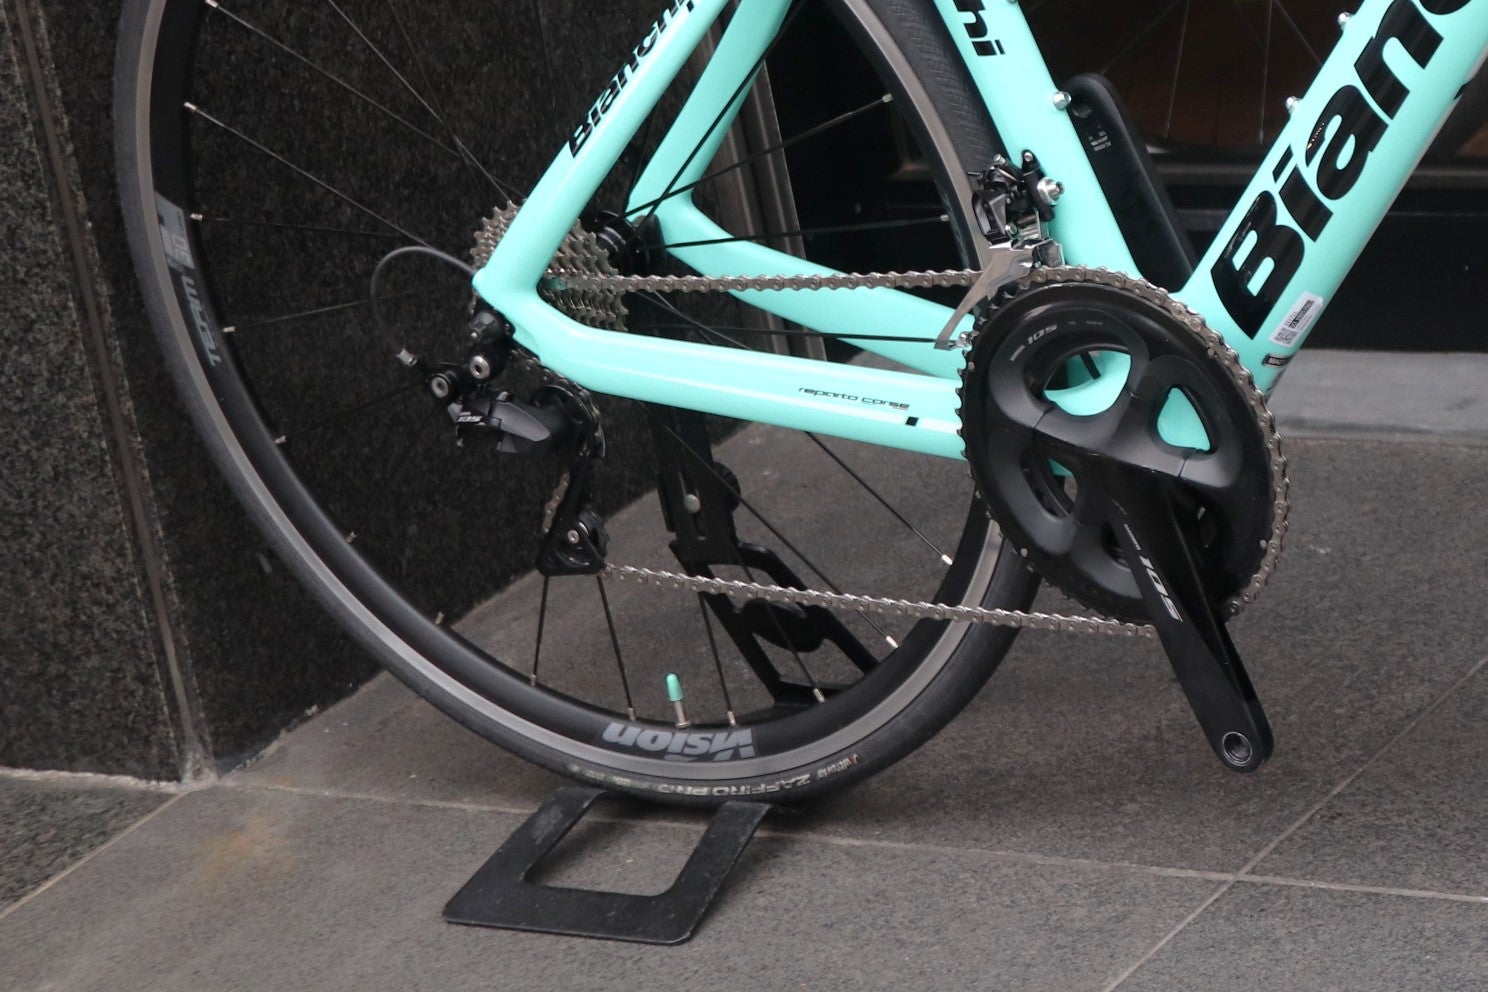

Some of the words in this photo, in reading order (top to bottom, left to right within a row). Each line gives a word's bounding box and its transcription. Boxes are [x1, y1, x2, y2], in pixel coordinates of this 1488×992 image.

[1028, 324, 1058, 345] 105
[798, 387, 859, 402] reparto
[861, 396, 910, 410] corse
[1139, 555, 1184, 624] 105
